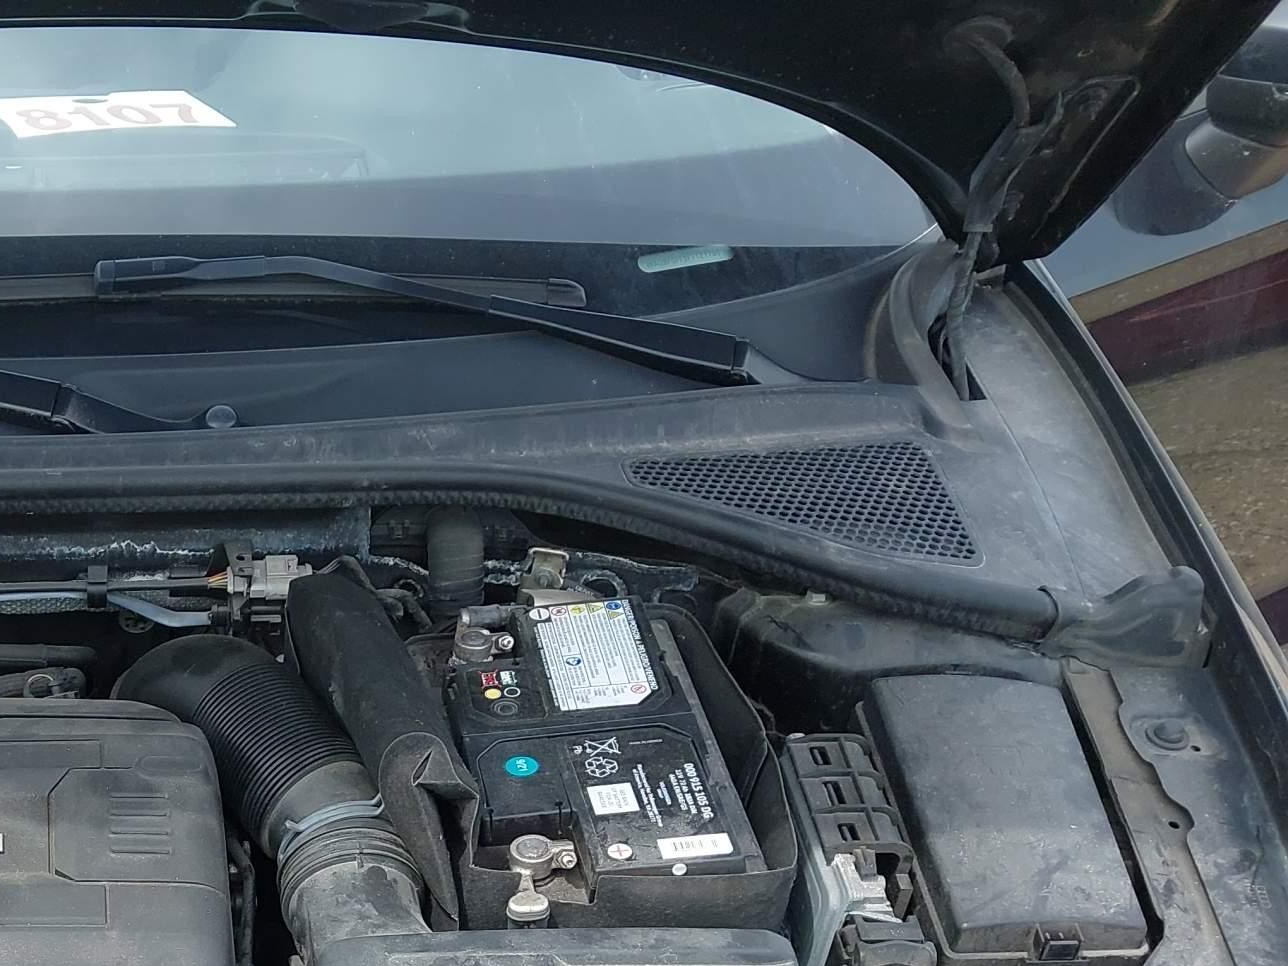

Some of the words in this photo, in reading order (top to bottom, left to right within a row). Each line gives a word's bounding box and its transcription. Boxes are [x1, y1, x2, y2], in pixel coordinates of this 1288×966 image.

[15, 102, 200, 131] 8107
[684, 763, 696, 777] 000
[690, 777, 703, 791] 915
[695, 792, 708, 805] 105
[701, 806, 714, 819] DG
